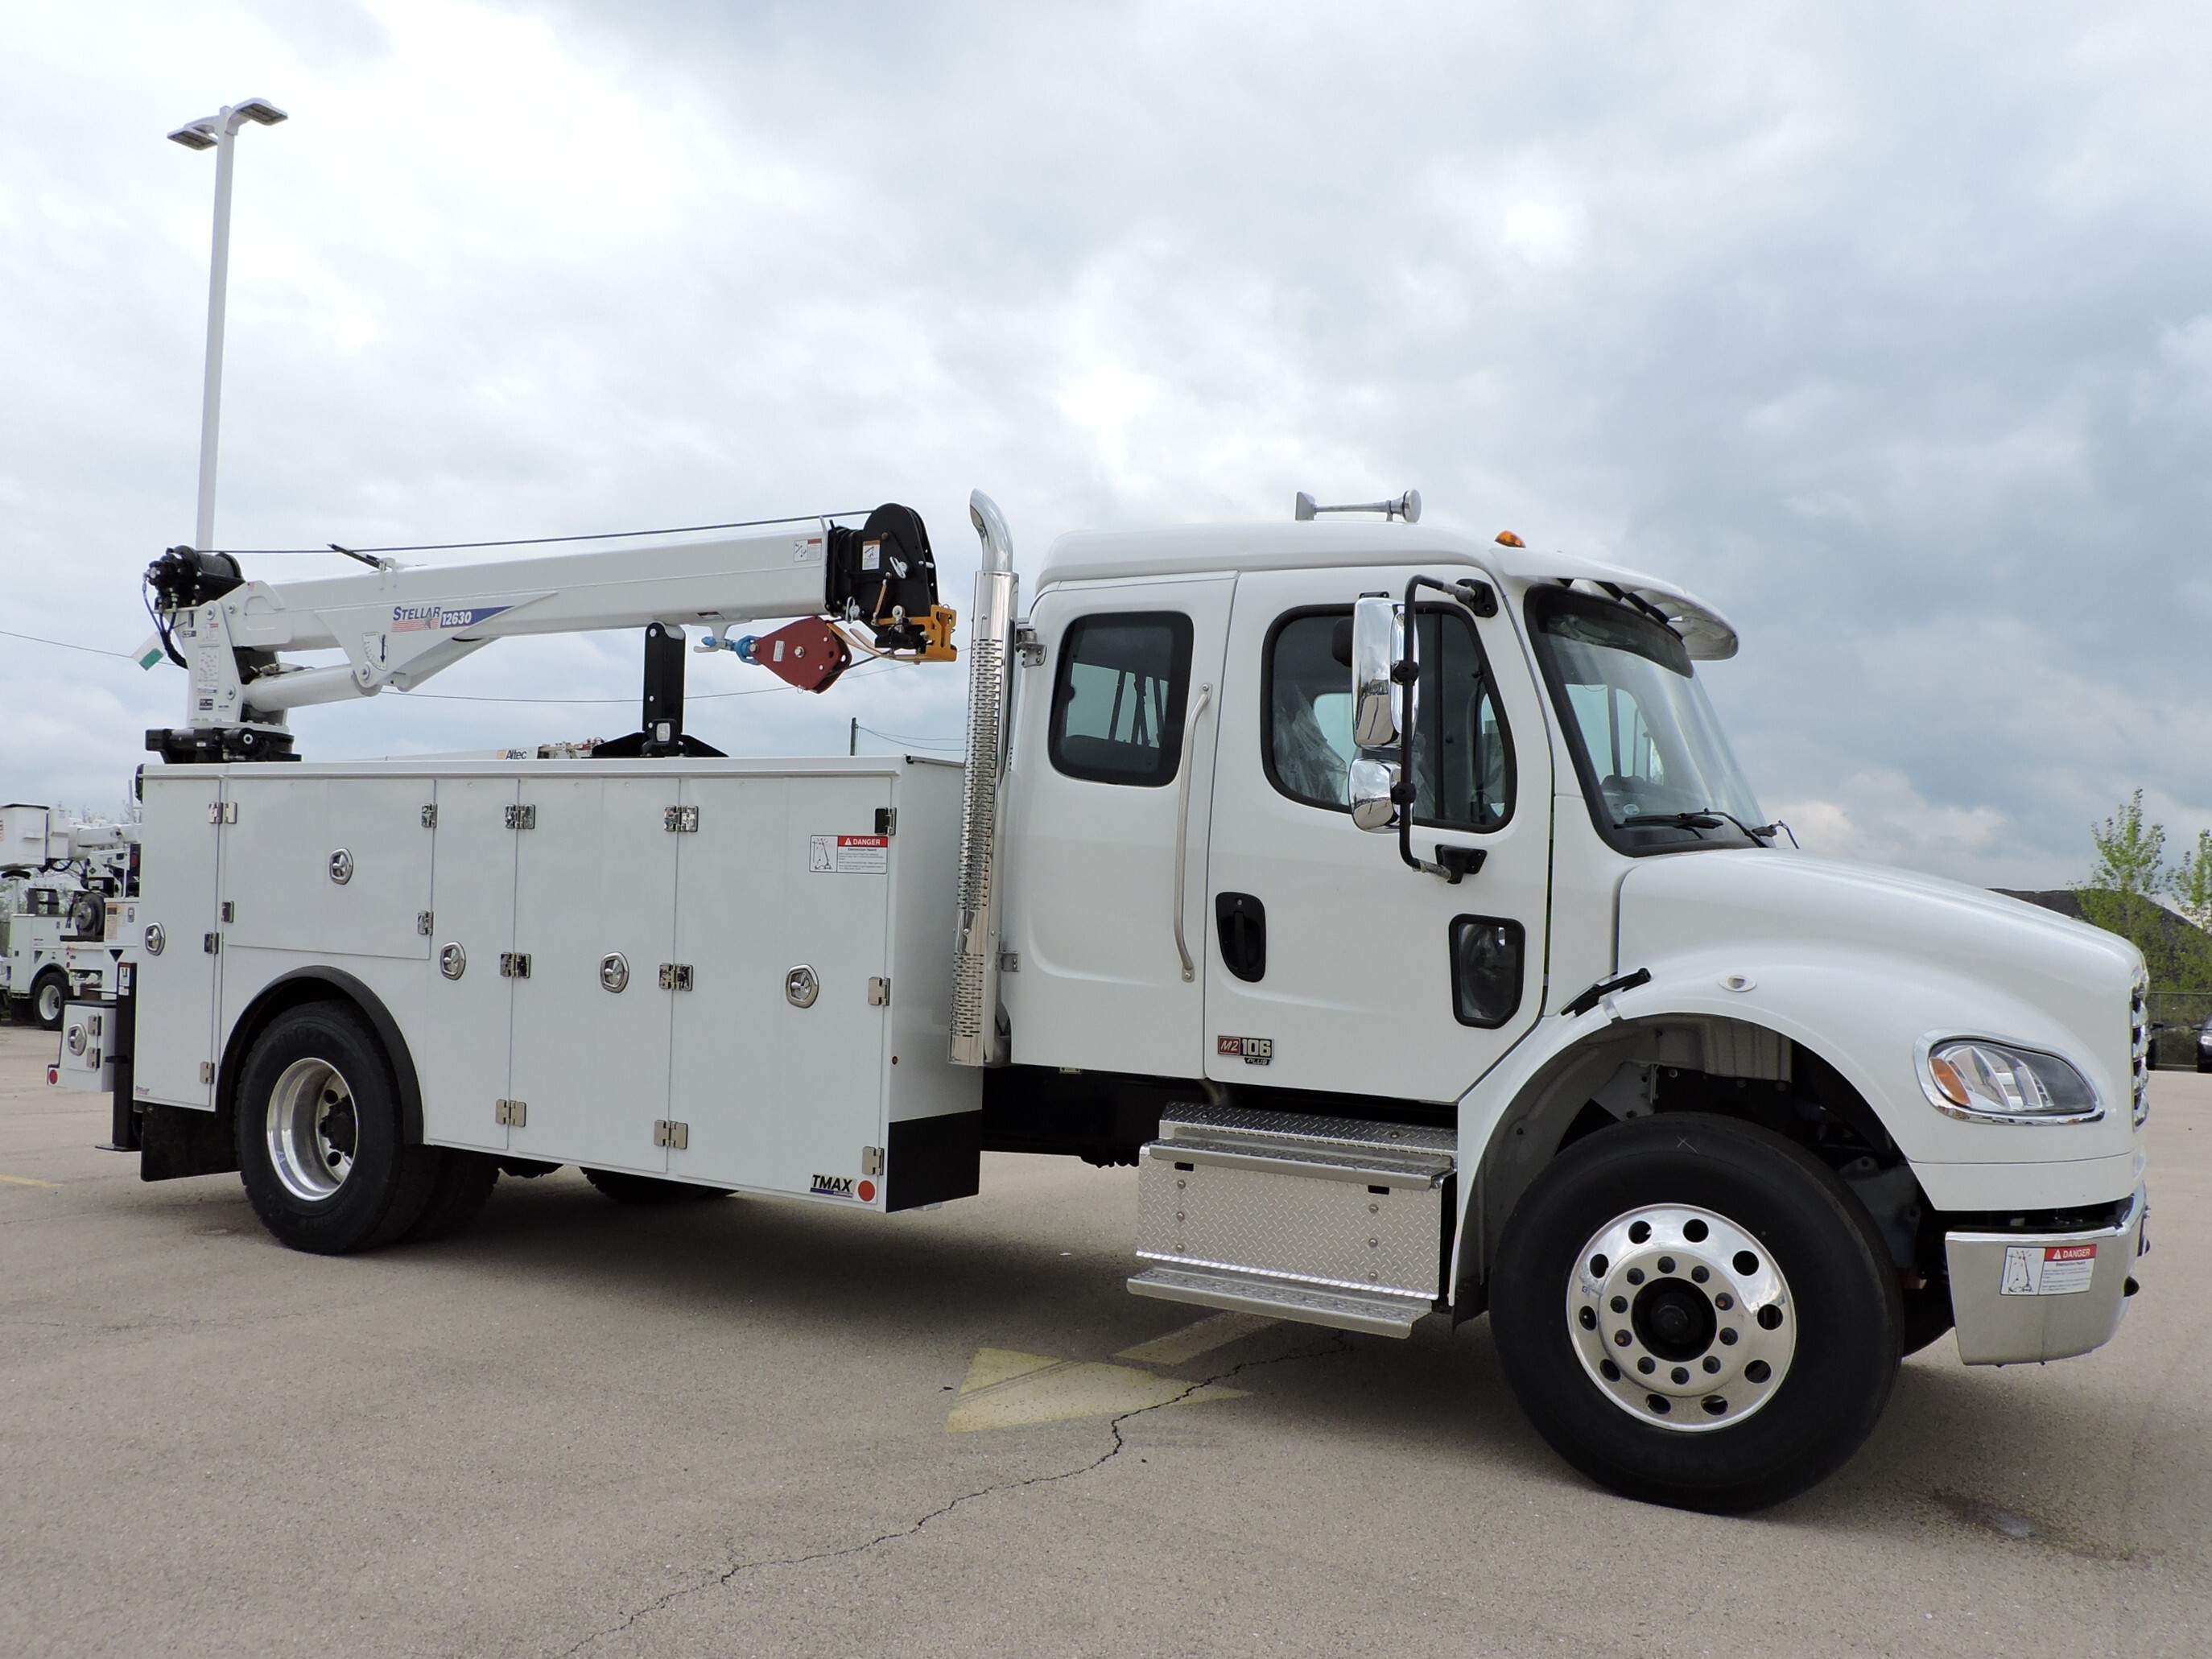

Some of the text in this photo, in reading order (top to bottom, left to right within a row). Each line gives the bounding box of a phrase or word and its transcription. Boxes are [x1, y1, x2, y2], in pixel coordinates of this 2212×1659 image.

[393, 606, 473, 625] STELLAR 12630
[506, 749, 527, 760] Altec
[1220, 1038, 1271, 1057] M2 106
[812, 1174, 852, 1192] TMAX
[2062, 1248, 2090, 1258] DANGER
